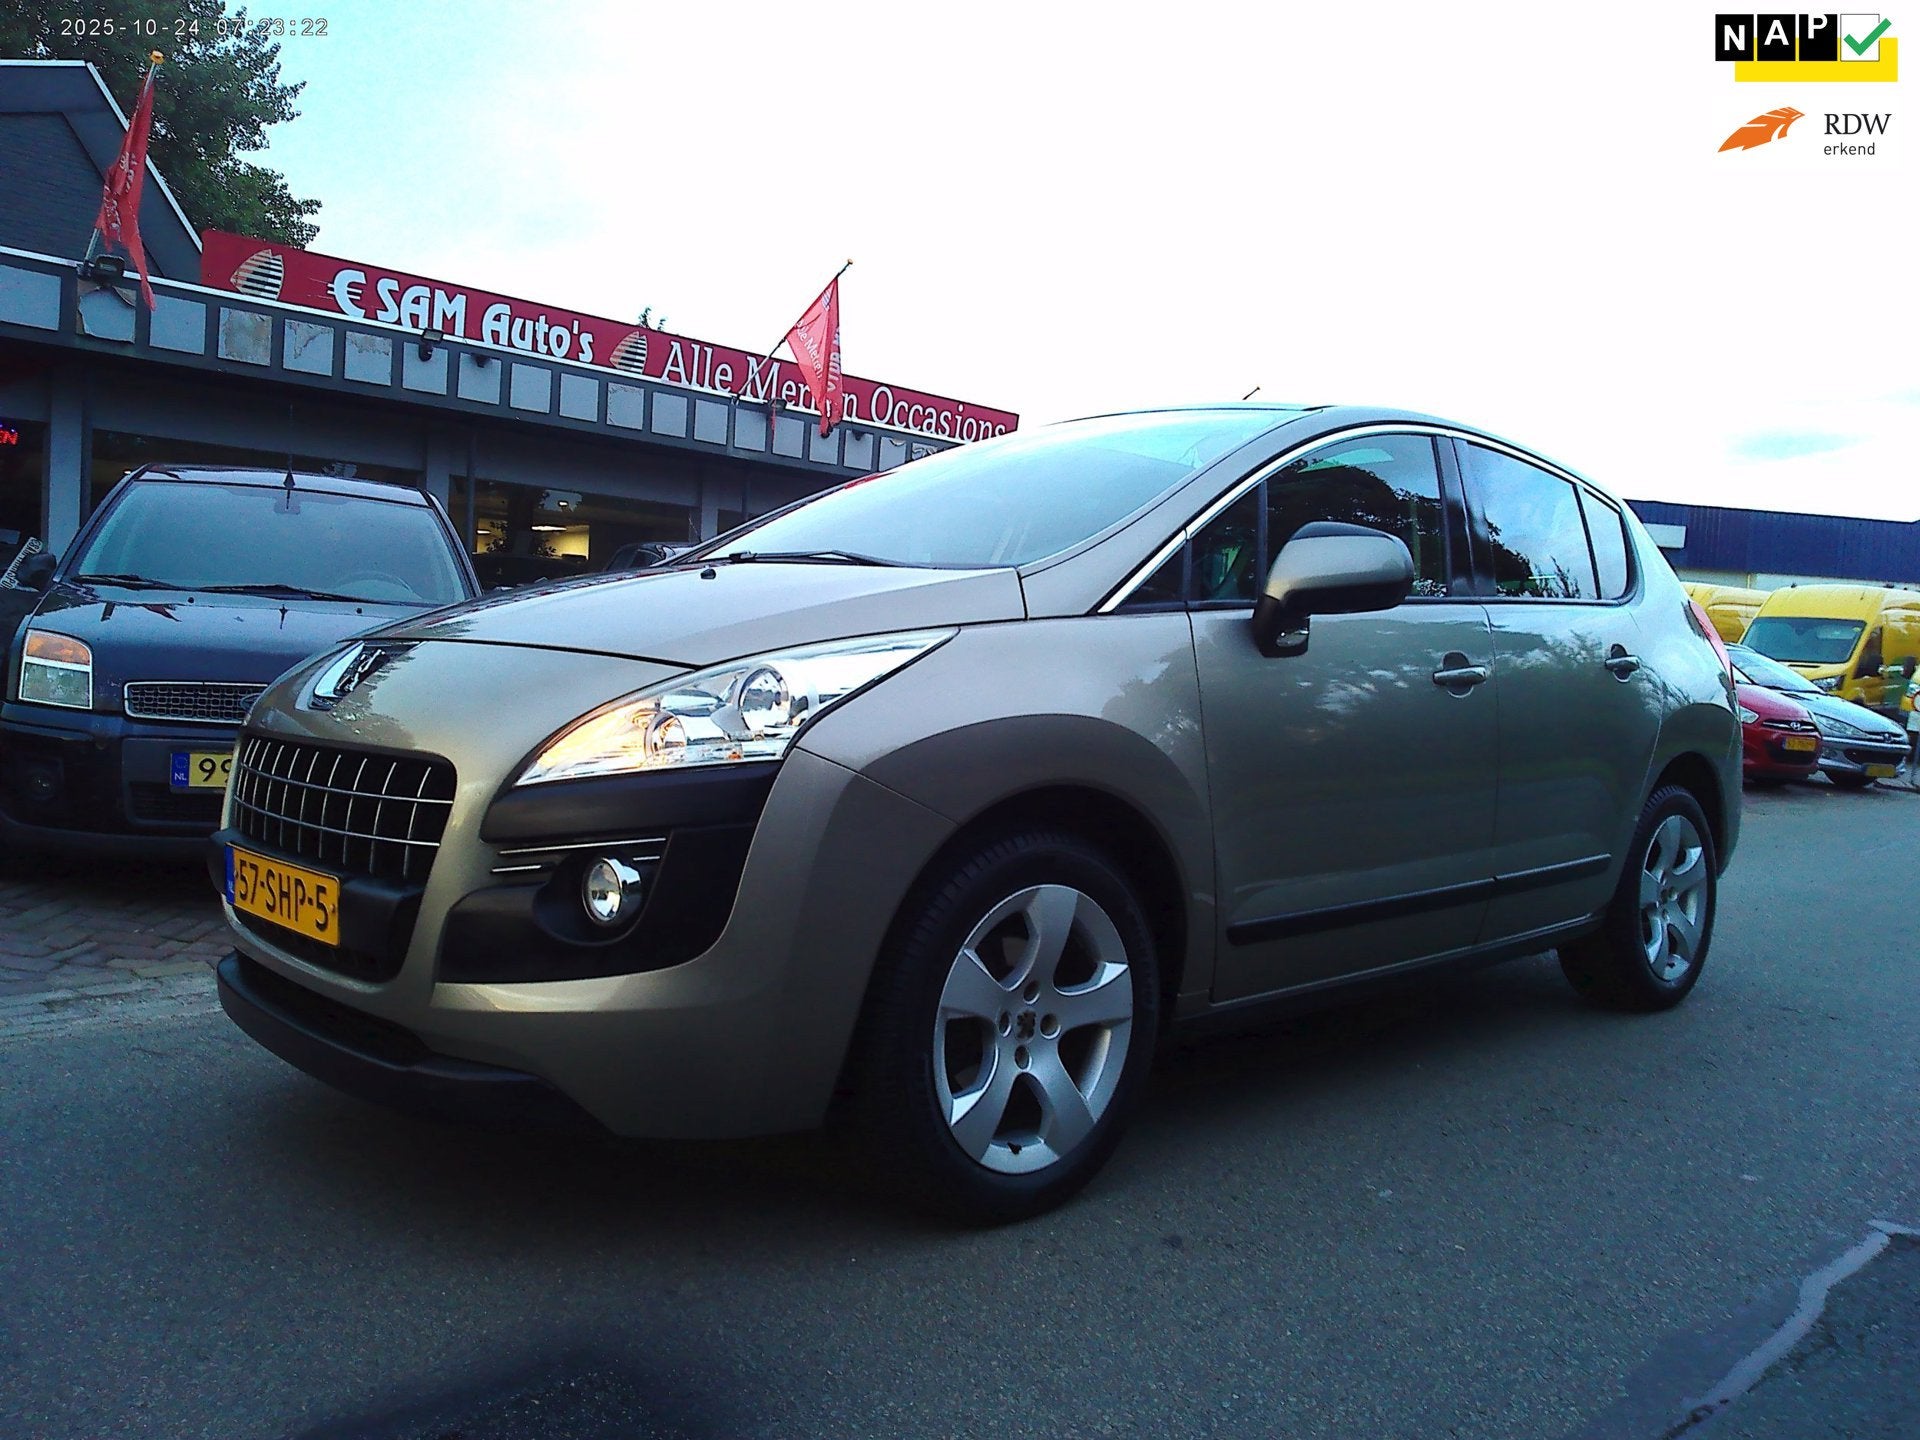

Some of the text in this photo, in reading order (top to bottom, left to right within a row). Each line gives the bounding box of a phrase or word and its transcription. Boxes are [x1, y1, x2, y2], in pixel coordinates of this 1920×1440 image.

[481, 303, 594, 364] Auto's
[661, 340, 734, 392] Alle
[239, 858, 330, 933] 57-SHP-5
